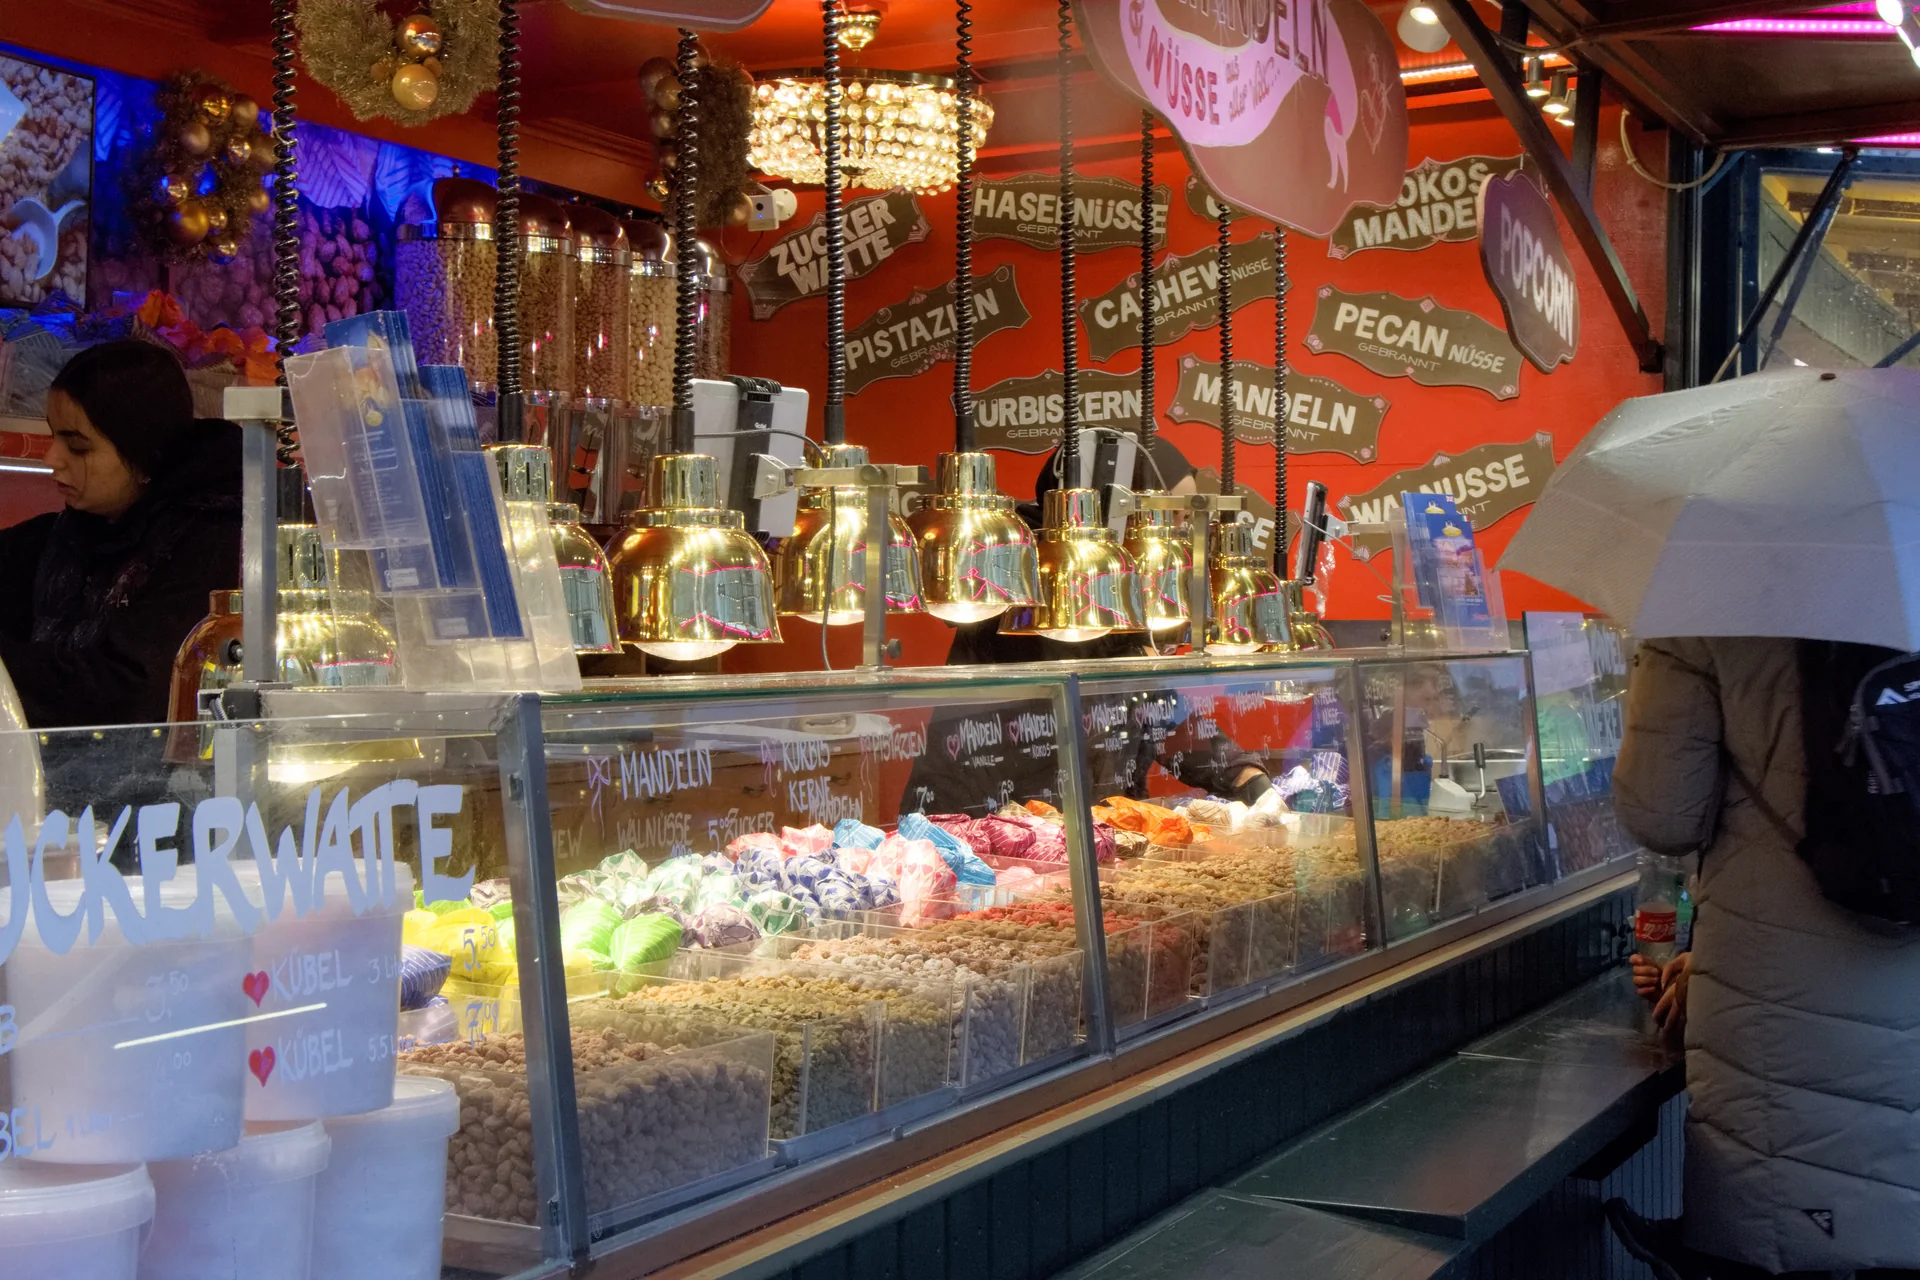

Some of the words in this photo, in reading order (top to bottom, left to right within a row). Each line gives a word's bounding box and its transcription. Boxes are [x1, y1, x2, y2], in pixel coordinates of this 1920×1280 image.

[1146, 25, 1220, 125] NÜSSE
[1396, 162, 1489, 207] OKOS
[973, 188, 1168, 234] HASELNÜSSE
[1232, 258, 1272, 281] NÜSSE
[1500, 203, 1573, 347] POPCORN
[1334, 302, 1449, 358] PECAN
[1448, 344, 1506, 373] NÜSSE
[1358, 341, 1441, 372] GEBRANNT
[1193, 373, 1357, 435] MANDELN
[960, 713, 1002, 755] MANDELN
[1018, 708, 1058, 743] MANDELN
[620, 747, 712, 800] MANDELN
[1032, 743, 1051, 759] KOKOS
[617, 811, 695, 850] WALNÜSSE
[270, 948, 353, 1000] KÜBEL
[368, 958, 380, 984] 3
[277, 1028, 354, 1083] KÜBEL
